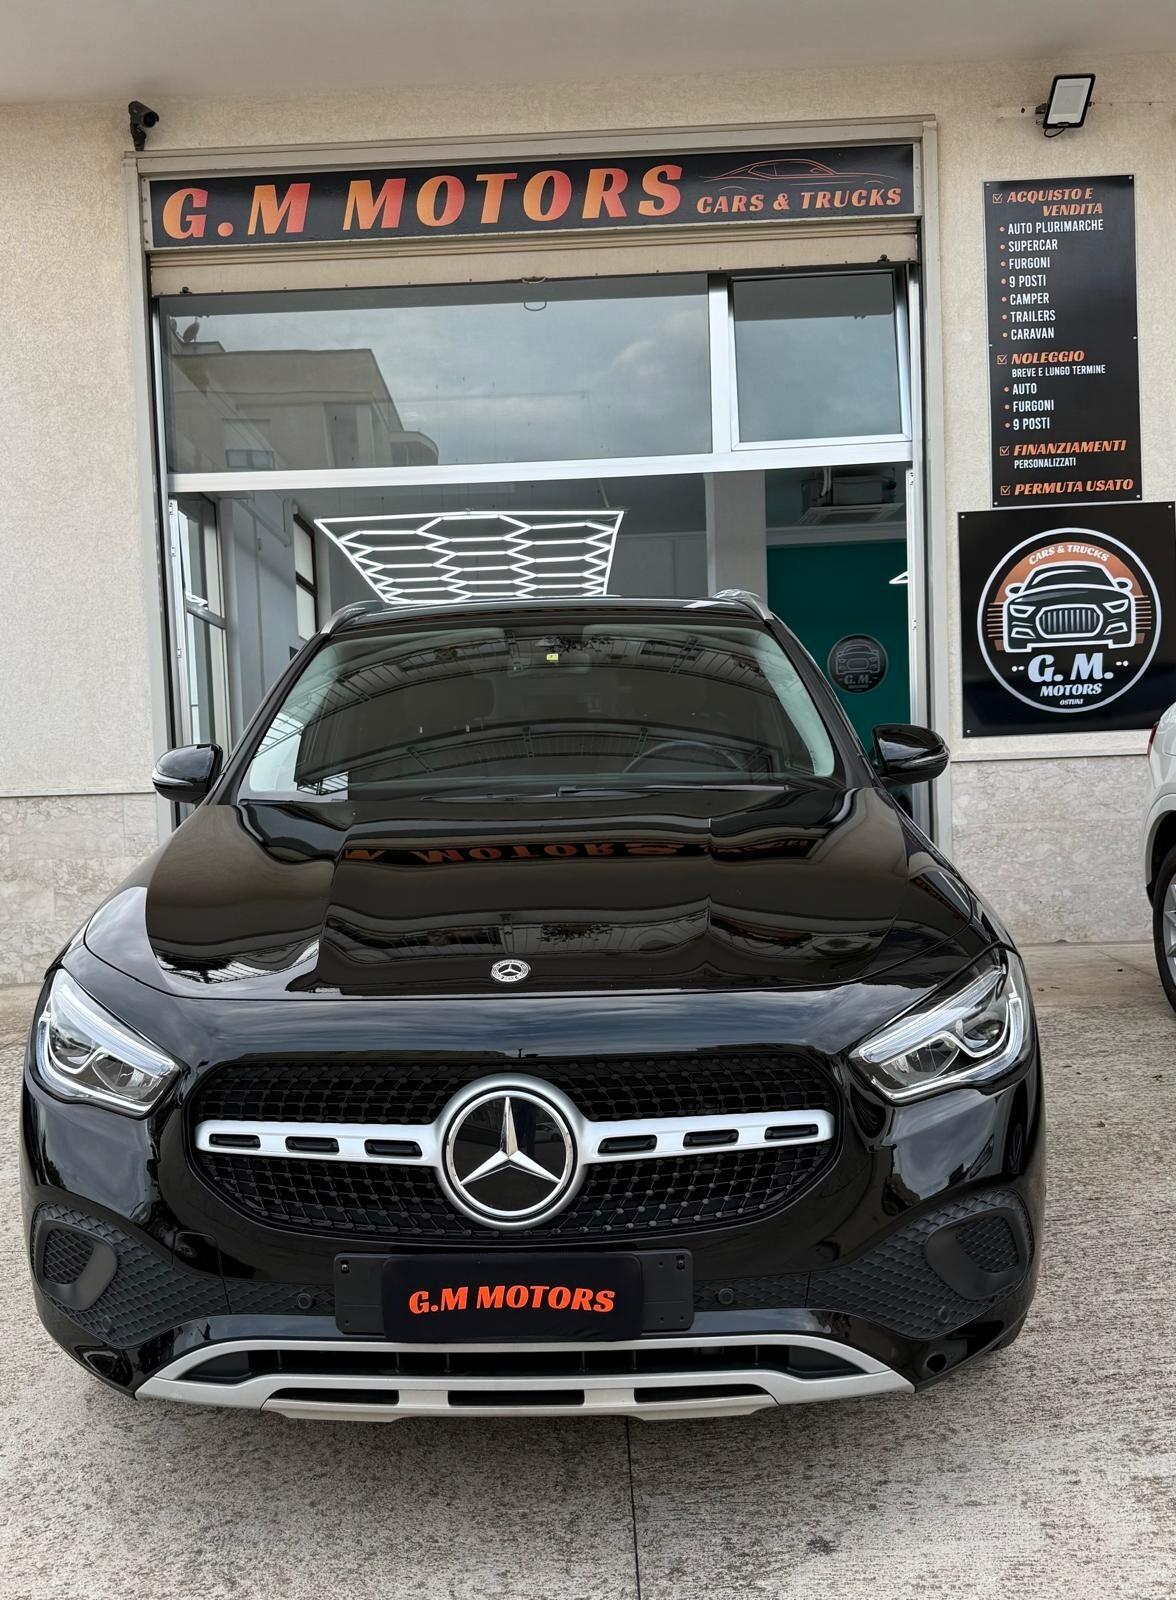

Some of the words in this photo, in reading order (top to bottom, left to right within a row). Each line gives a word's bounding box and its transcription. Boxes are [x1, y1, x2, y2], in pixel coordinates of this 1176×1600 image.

[163, 183, 311, 240] G.M
[343, 164, 683, 231] MOTORS
[697, 194, 764, 214] CARS
[773, 193, 790, 211] &
[801, 187, 901, 209] TRUCKS
[1007, 188, 1082, 204] ACQUISTO
[1085, 188, 1094, 199] E
[1043, 203, 1103, 216] VENDITA
[1008, 223, 1032, 235] AUTO
[1036, 219, 1103, 233] PLURIMARCHE
[1008, 239, 1058, 252] SUPERCAR
[1009, 257, 1050, 269] FURGONI
[1009, 276, 1015, 287] 9
[1019, 275, 1046, 287] POSTI
[1010, 293, 1049, 305] CAMPER
[1010, 310, 1056, 323] TRAILERS
[1011, 327, 1054, 340] CARAVAN
[1011, 350, 1085, 365] NOLEGGIO
[1012, 367, 1036, 378] BREVE
[1038, 367, 1043, 376] E
[1045, 366, 1070, 376] LUNGO
[1072, 365, 1106, 375] TERMINE
[1012, 383, 1037, 395] AUTO
[1013, 400, 1054, 412] FURGONI
[1013, 419, 1019, 430] 9
[1023, 417, 1050, 430] POSTI
[1013, 440, 1127, 456] FINANZIAMENTI
[1014, 457, 1076, 469] PERSONALIZZATI
[1014, 481, 1083, 495] PERMUTA
[1086, 479, 1134, 492] USATO
[1029, 547, 1055, 565] CARS
[1057, 545, 1065, 554] &
[1067, 544, 1110, 562] TRUCKS
[1027, 654, 1064, 683] G.
[1070, 652, 1114, 681] M.
[1040, 683, 1102, 697] MOTORS
[409, 1286, 468, 1315] G.M
[476, 1285, 616, 1313] MOTORS
